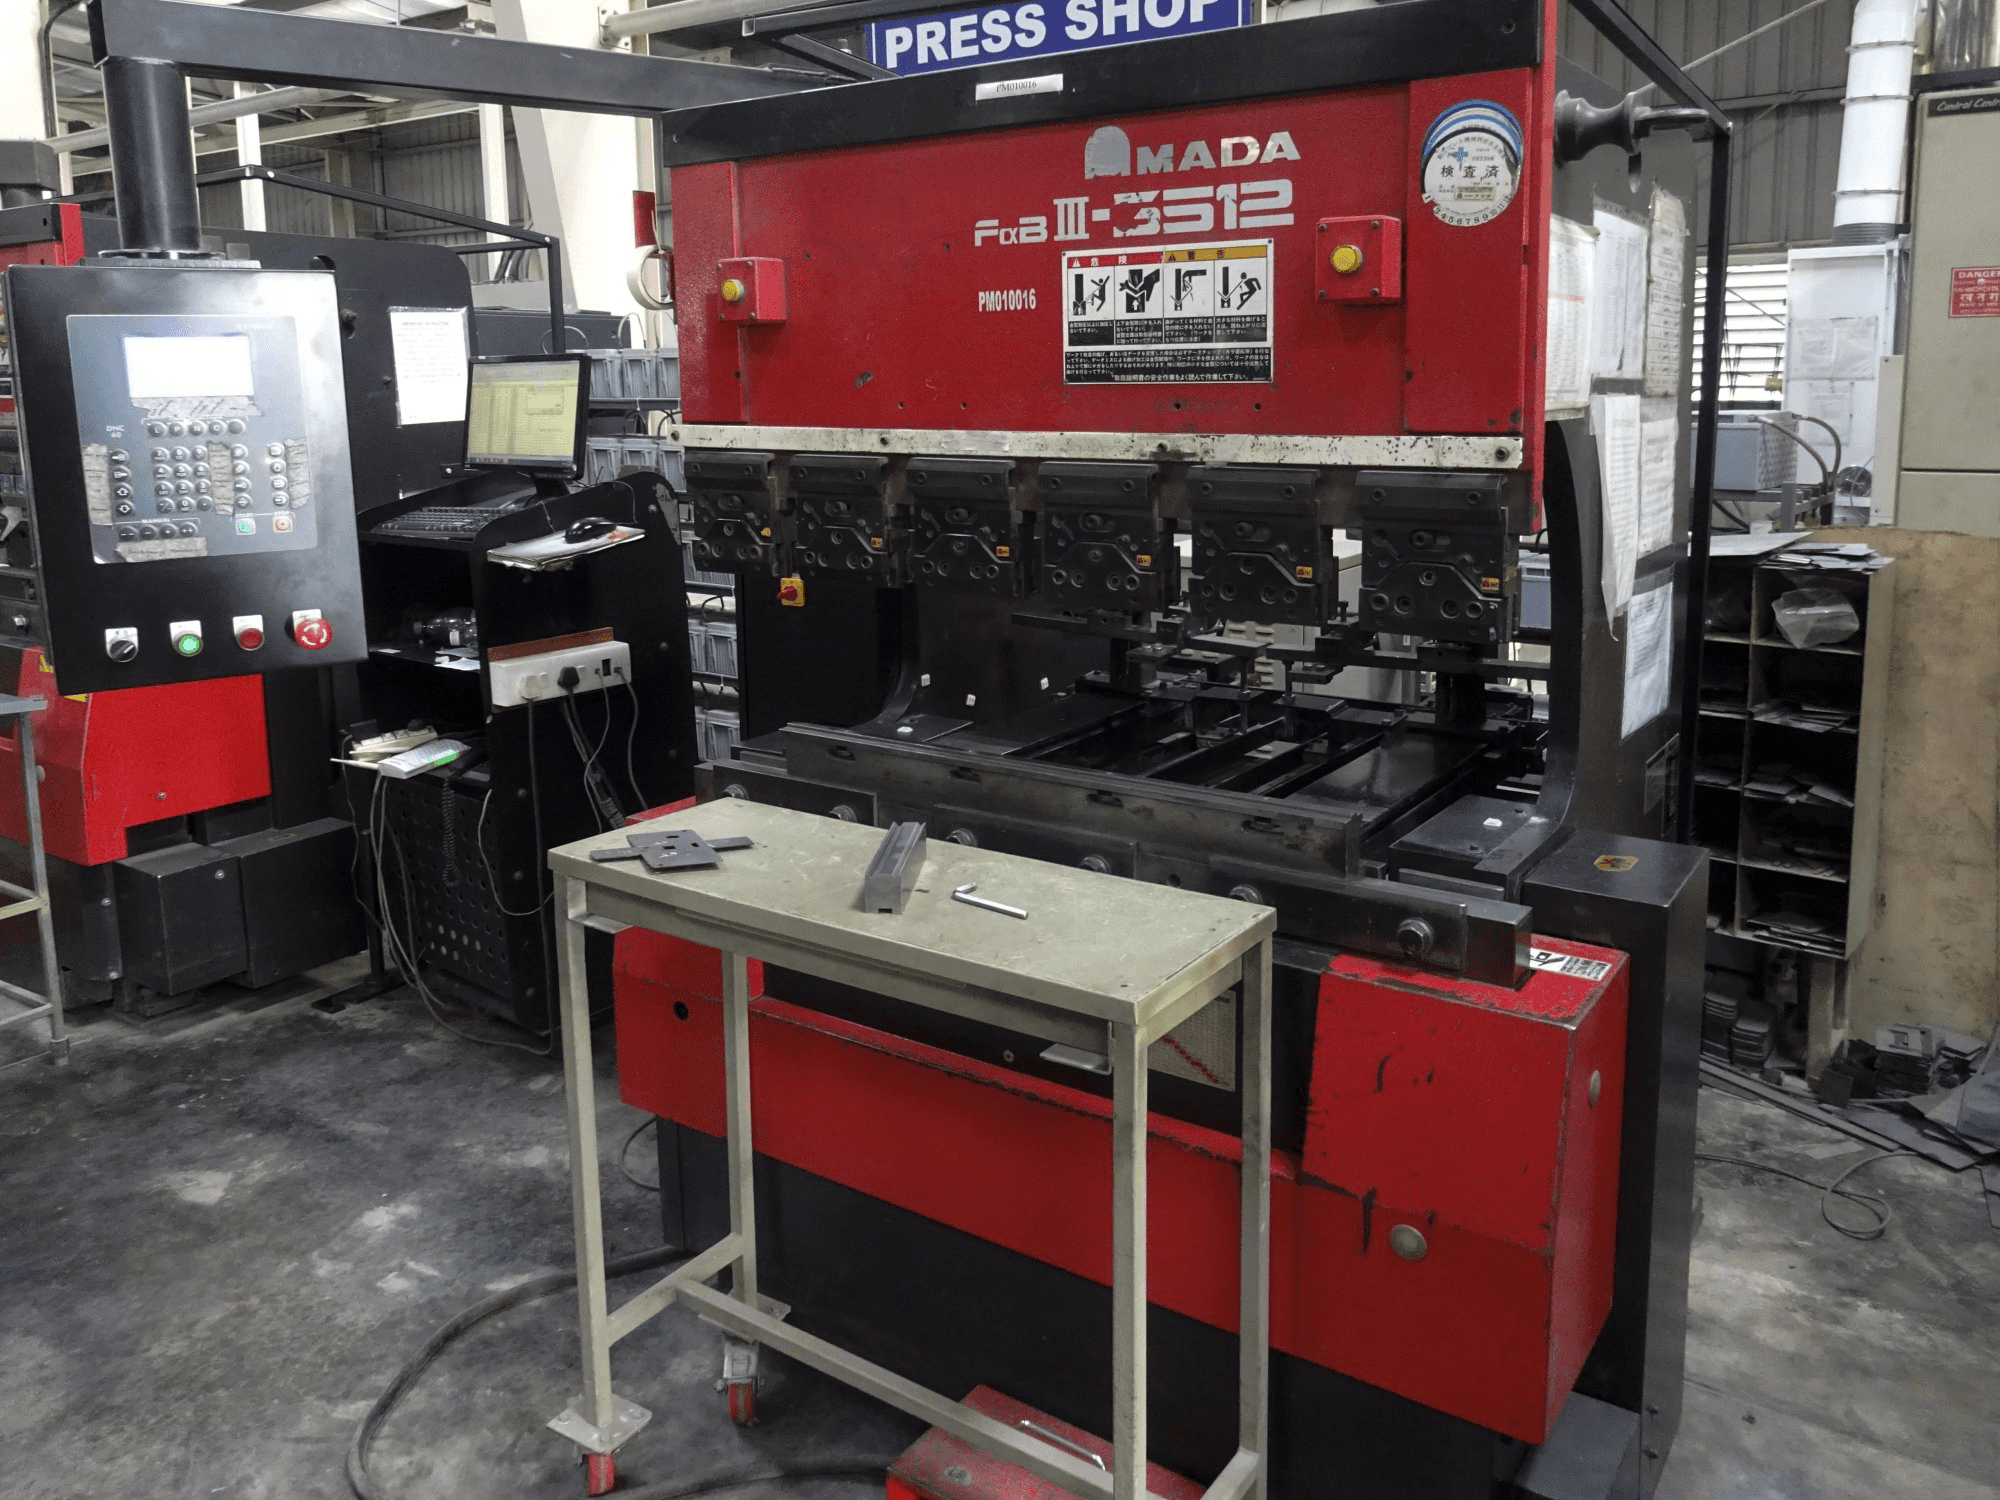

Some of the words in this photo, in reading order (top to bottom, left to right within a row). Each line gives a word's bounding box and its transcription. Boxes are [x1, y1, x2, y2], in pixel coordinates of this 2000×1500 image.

[885, 4, 1046, 68] PRESS
[1064, 0, 1219, 40] SHOP
[996, 80, 1037, 92] PM010016
[978, 288, 1036, 312] PM010016
